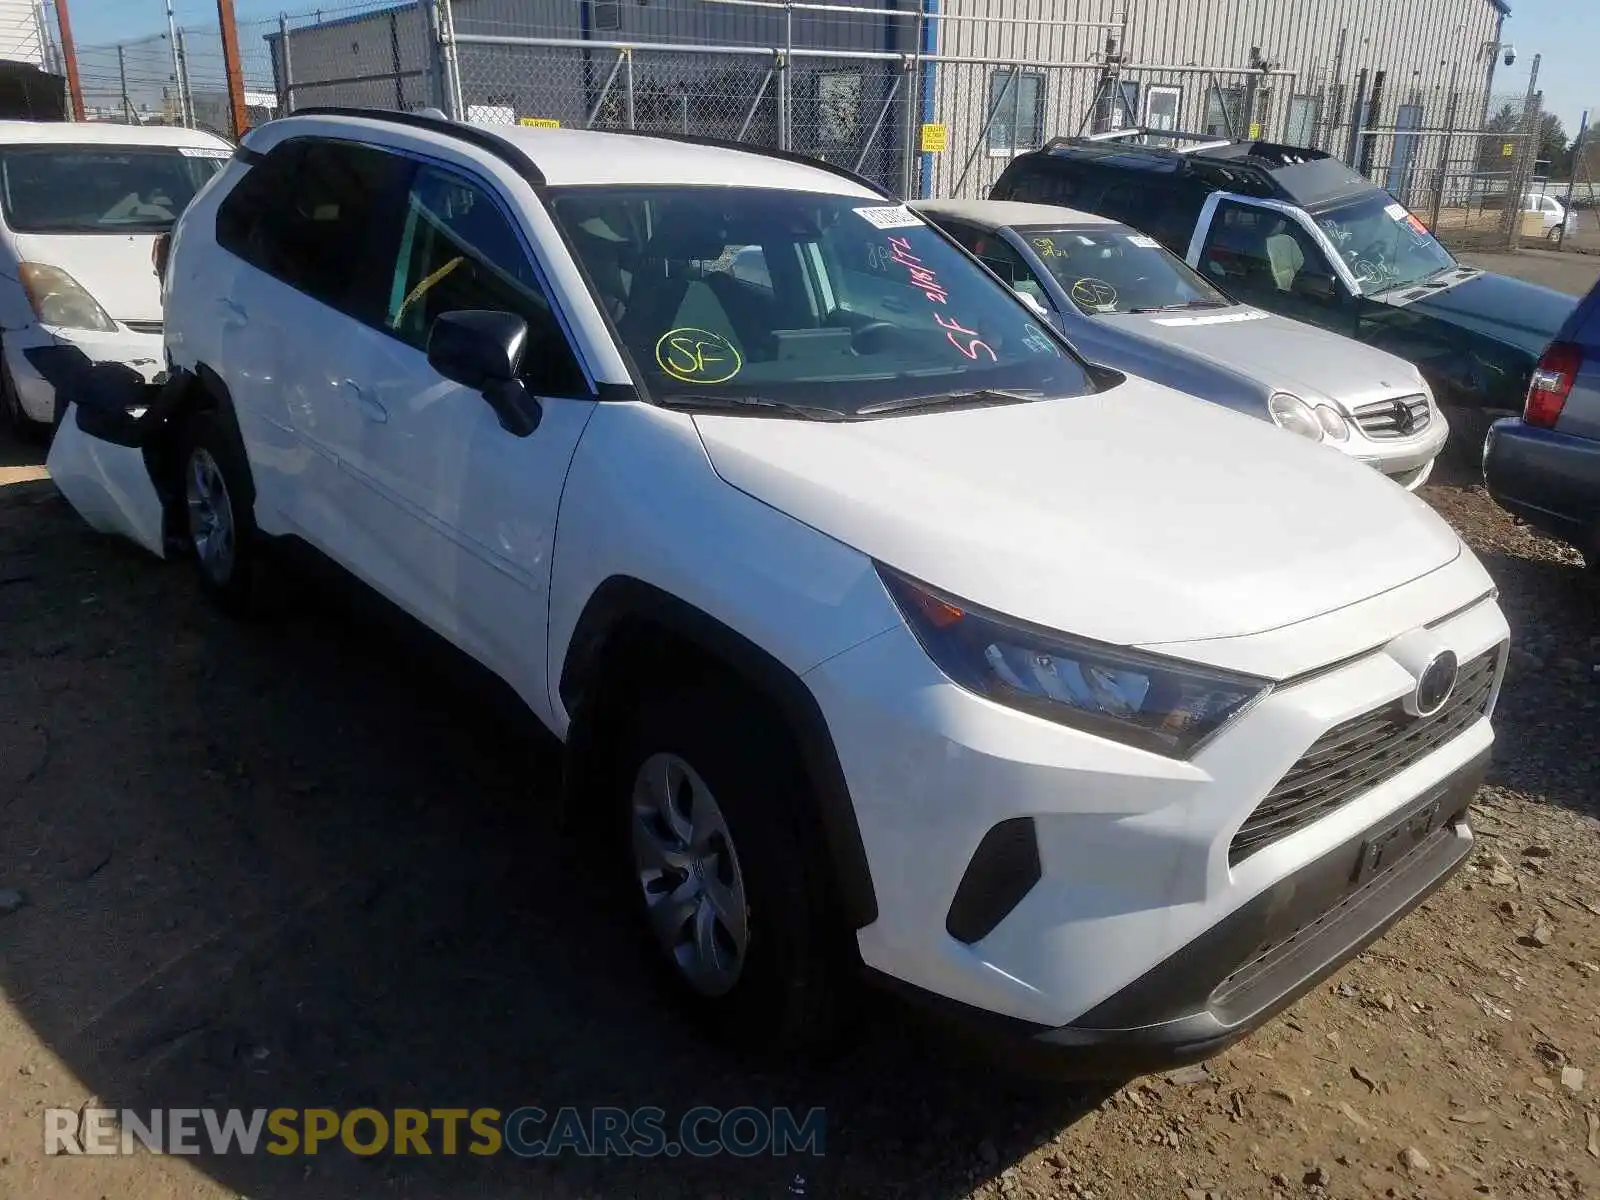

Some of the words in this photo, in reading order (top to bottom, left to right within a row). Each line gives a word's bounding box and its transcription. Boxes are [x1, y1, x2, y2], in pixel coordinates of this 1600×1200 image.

[522, 119, 558, 129] WARNING
[933, 311, 998, 362] SF
[667, 337, 725, 373] SF
